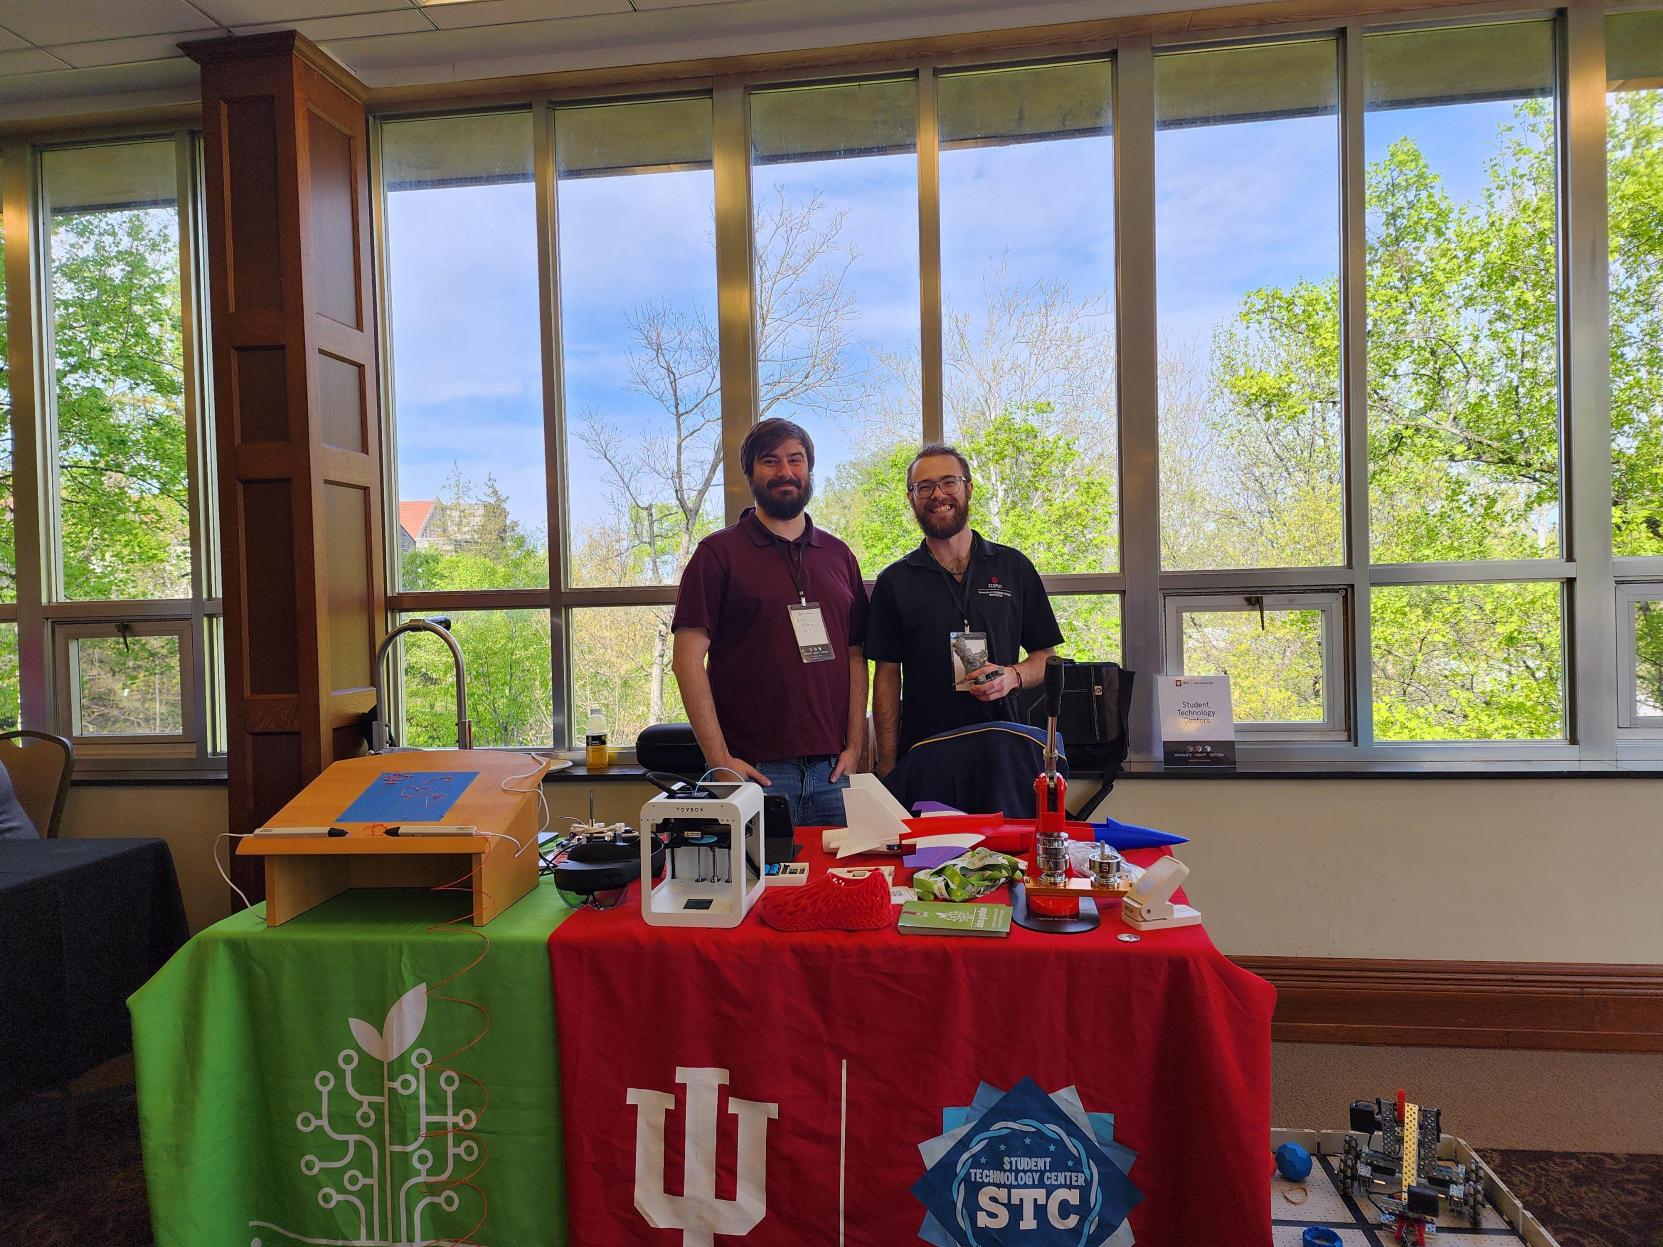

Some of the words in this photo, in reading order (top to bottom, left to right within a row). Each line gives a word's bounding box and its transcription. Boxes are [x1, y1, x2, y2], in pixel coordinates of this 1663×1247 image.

[1177, 709, 1216, 717] Technology
[1003, 1157, 1052, 1171] STUDENT
[969, 1169, 1041, 1185] TECHNOLOGY
[1044, 1172, 1086, 1186] CENTER
[977, 1186, 1081, 1230] STC
